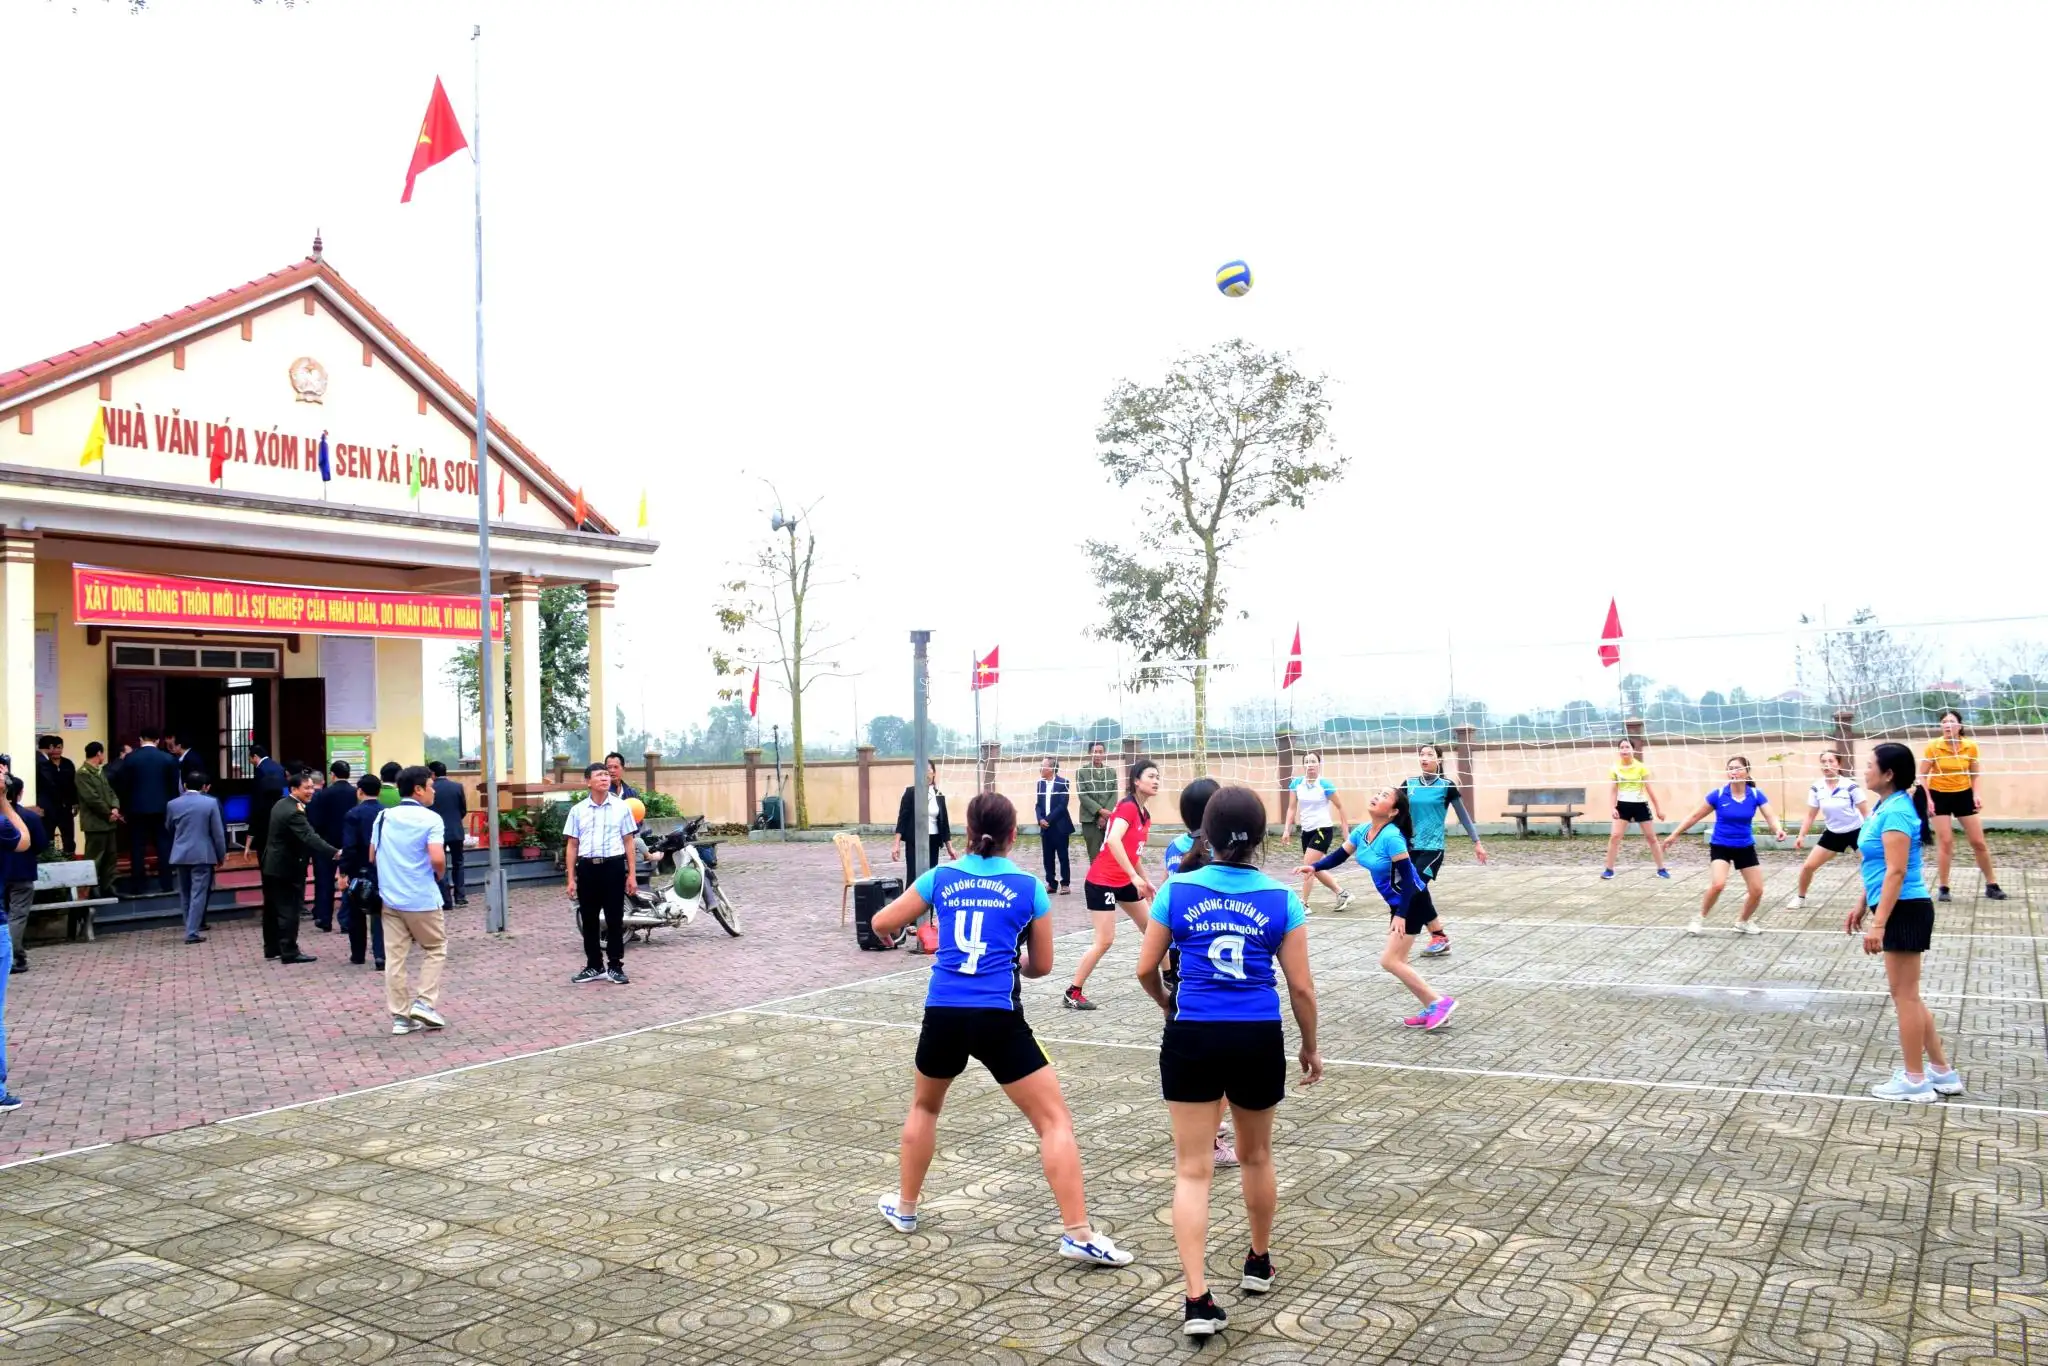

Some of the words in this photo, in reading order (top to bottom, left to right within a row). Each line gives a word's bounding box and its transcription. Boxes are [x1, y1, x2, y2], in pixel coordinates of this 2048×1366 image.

[102, 403, 148, 450] NHÀ
[155, 408, 199, 457] VĂN
[254, 425, 299, 470] XÓM
[336, 443, 372, 480] SEN
[377, 445, 401, 484] XÃ
[445, 460, 480, 496] SƠN
[84, 580, 108, 611] XÂY
[111, 584, 144, 617] DỰNG
[147, 584, 178, 614] NÔNG
[181, 586, 211, 616] THÔN
[213, 588, 234, 617] MỚI
[236, 589, 249, 618] LÀ
[252, 593, 267, 624] SỰ
[268, 592, 304, 626] NGHIỆP
[307, 591, 327, 621] CỦA
[328, 596, 355, 623] NHÂN
[357, 597, 380, 627] DÂN,
[381, 602, 394, 625] DO
[395, 600, 420, 627] NHÂN
[422, 602, 443, 631] DÂN,
[444, 603, 453, 629] VÌ
[454, 604, 477, 630] NHÂN
[961, 898, 976, 907] SEN
[1199, 897, 1223, 914] BÓNG
[954, 909, 988, 975] 4
[1211, 922, 1227, 931] SEN
